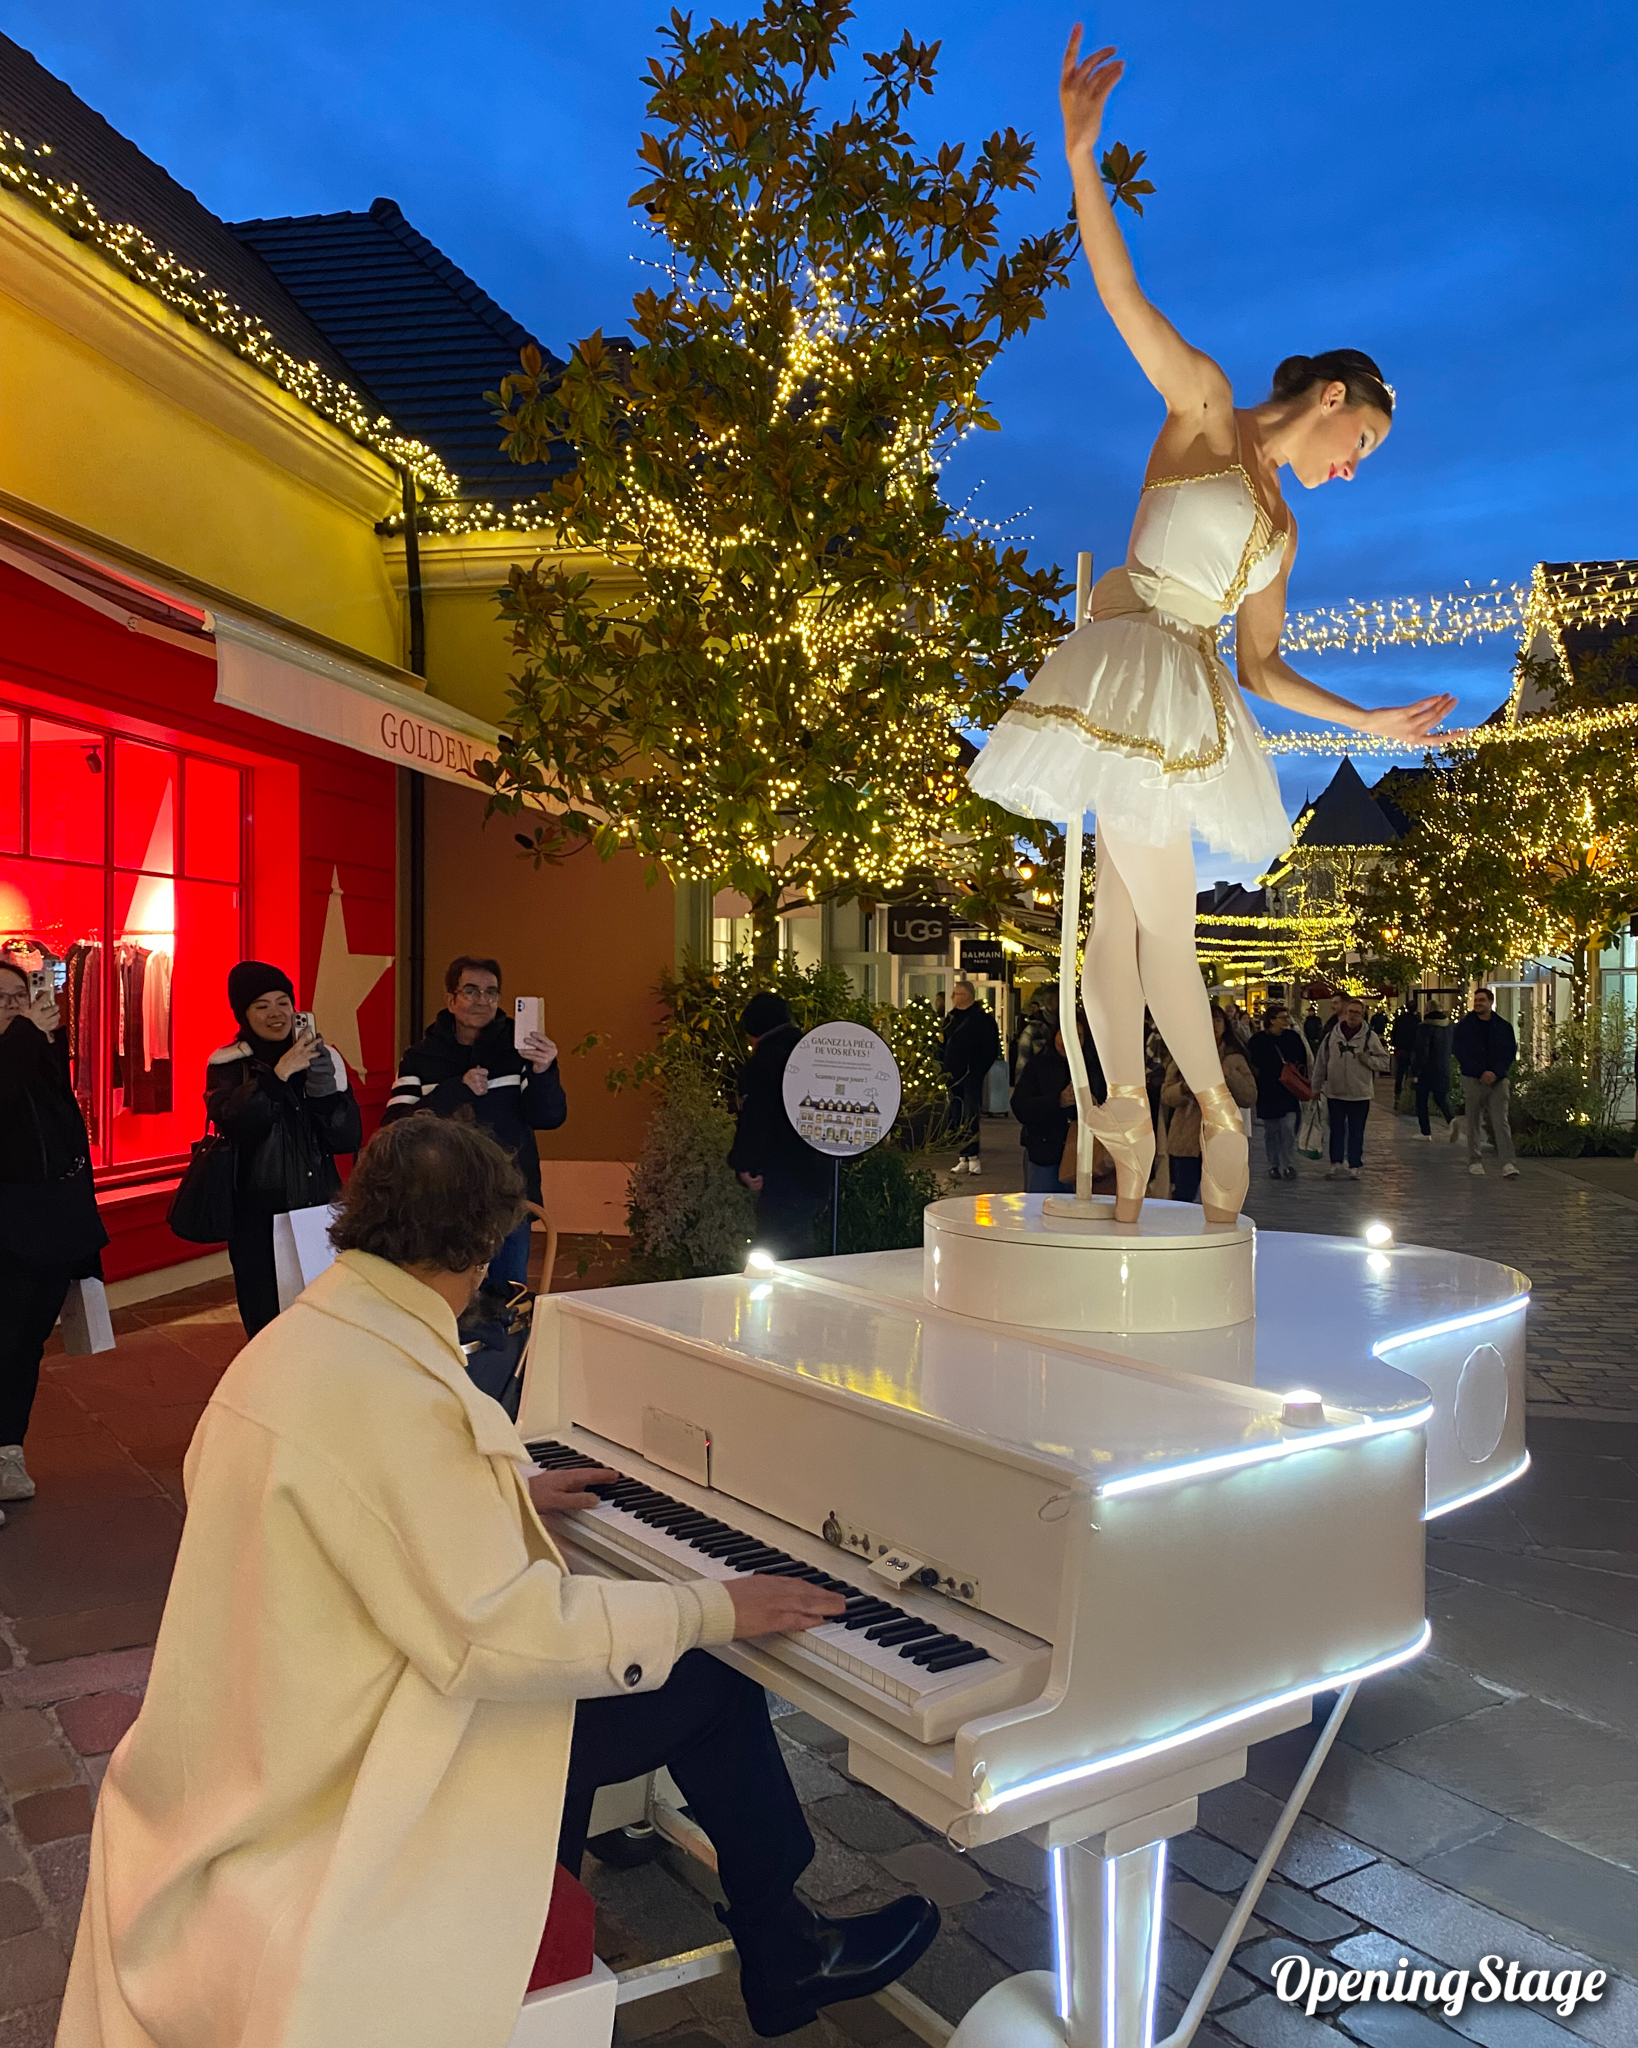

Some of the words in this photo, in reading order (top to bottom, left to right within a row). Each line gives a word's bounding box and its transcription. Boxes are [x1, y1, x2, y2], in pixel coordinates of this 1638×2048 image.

[381, 712, 472, 774] GOLDEN
[893, 919, 943, 943] UGG
[962, 951, 1001, 959] BALMAIN
[811, 1037, 841, 1047] GAGNEZ
[842, 1039, 852, 1047] LA
[853, 1039, 875, 1048] PIÈCE
[843, 1048, 866, 1057] RÊVES
